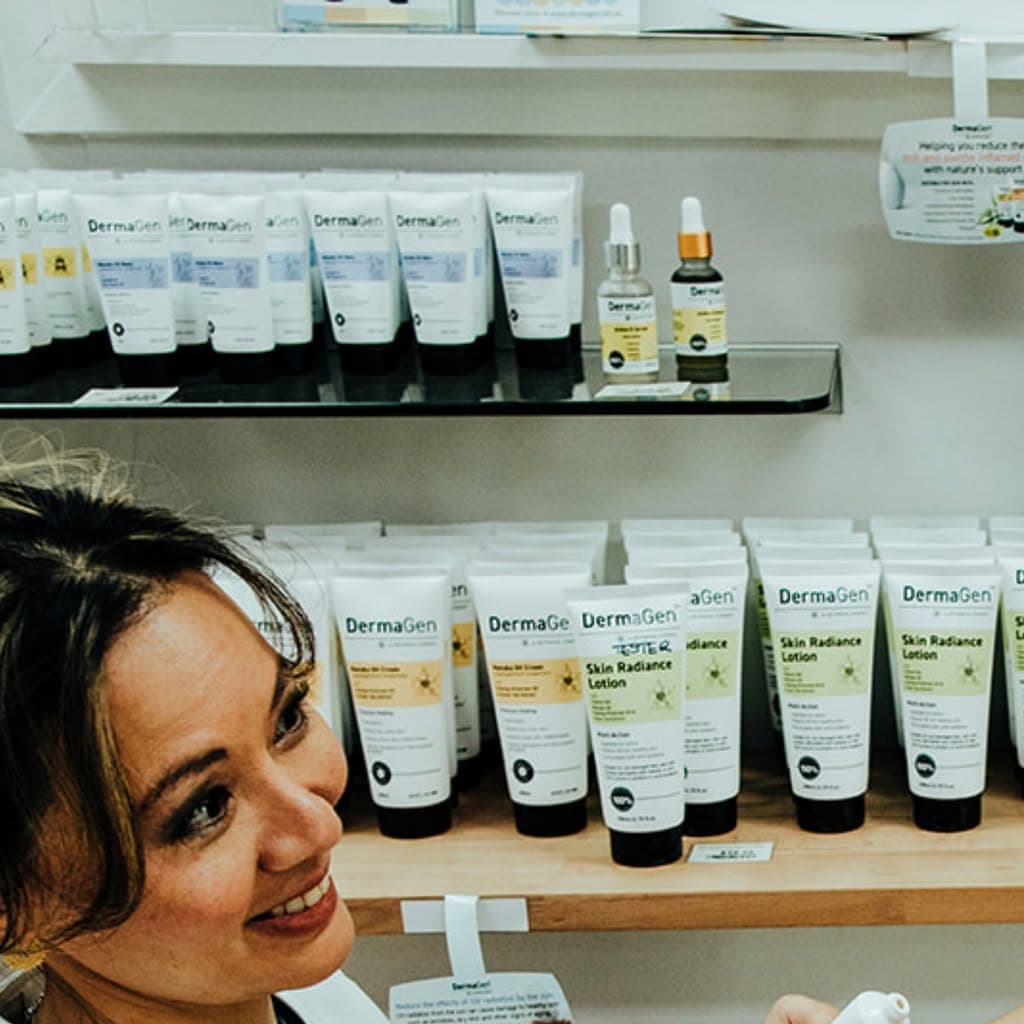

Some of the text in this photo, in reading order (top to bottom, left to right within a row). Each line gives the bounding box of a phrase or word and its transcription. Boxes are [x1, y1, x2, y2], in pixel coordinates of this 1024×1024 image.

[919, 142, 955, 152] Helping
[958, 143, 974, 152] you
[976, 141, 1007, 150] reduce
[924, 165, 1023, 175] with nature's support
[188, 218, 252, 232] DermaGen
[314, 214, 382, 228] DermaGen
[396, 214, 460, 228] DermaGen
[495, 211, 558, 225] DermaGen
[88, 219, 162, 233] DermaGen
[780, 586, 869, 605] DermaGen
[903, 586, 992, 603] DermaGen
[346, 616, 438, 634] DermaGen
[489, 614, 570, 632] DermaGe
[582, 607, 677, 629] DermaGen
[780, 635, 862, 649] Skin Radiance
[902, 635, 983, 647] Skin Radiance
[612, 640, 672, 657] TESTER
[902, 649, 938, 661] Lotion
[781, 652, 818, 663] Lotion
[586, 660, 672, 676] Skin Radiance
[588, 677, 627, 690] Lotion
